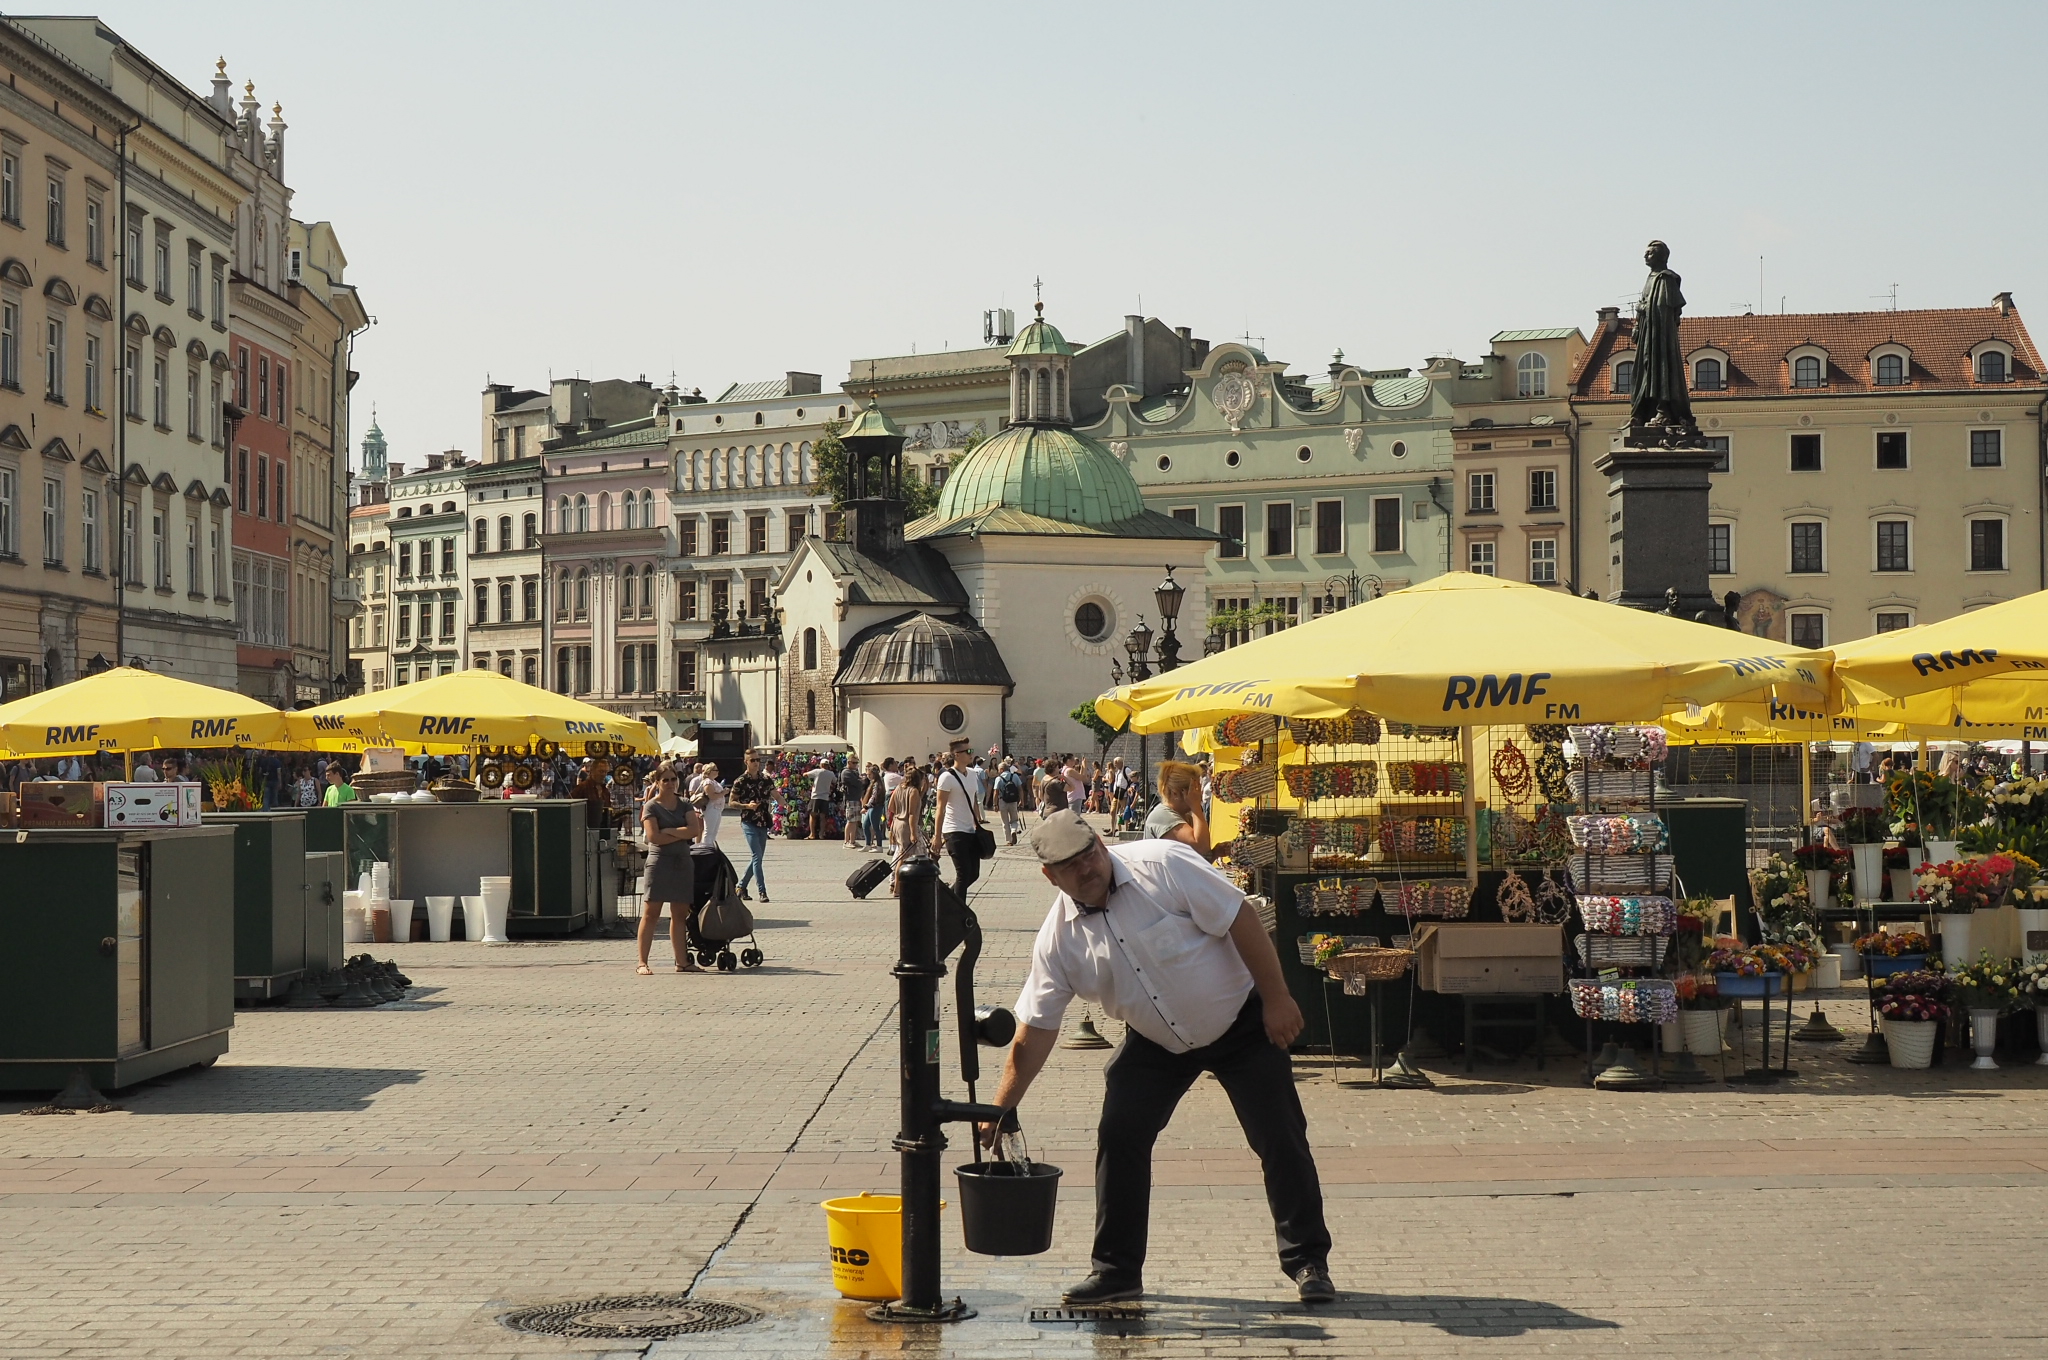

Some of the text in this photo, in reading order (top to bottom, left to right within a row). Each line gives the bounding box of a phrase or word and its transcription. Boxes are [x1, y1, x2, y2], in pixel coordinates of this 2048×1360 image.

[1718, 656, 1816, 685] RMF FM
[1912, 649, 2046, 676] RMF FM
[1242, 692, 1273, 708] FM
[1442, 672, 1580, 719] RMF FM
[191, 718, 252, 742] RMF FM
[312, 714, 363, 736] RMF FM
[419, 715, 489, 743] RMF FM
[565, 720, 624, 742] RMF FM
[1833, 717, 1855, 729] FM
[2023, 726, 2048, 739] FM
[46, 724, 117, 748] RMF FM
[23, 819, 91, 827] PREMIUM BANANAS
